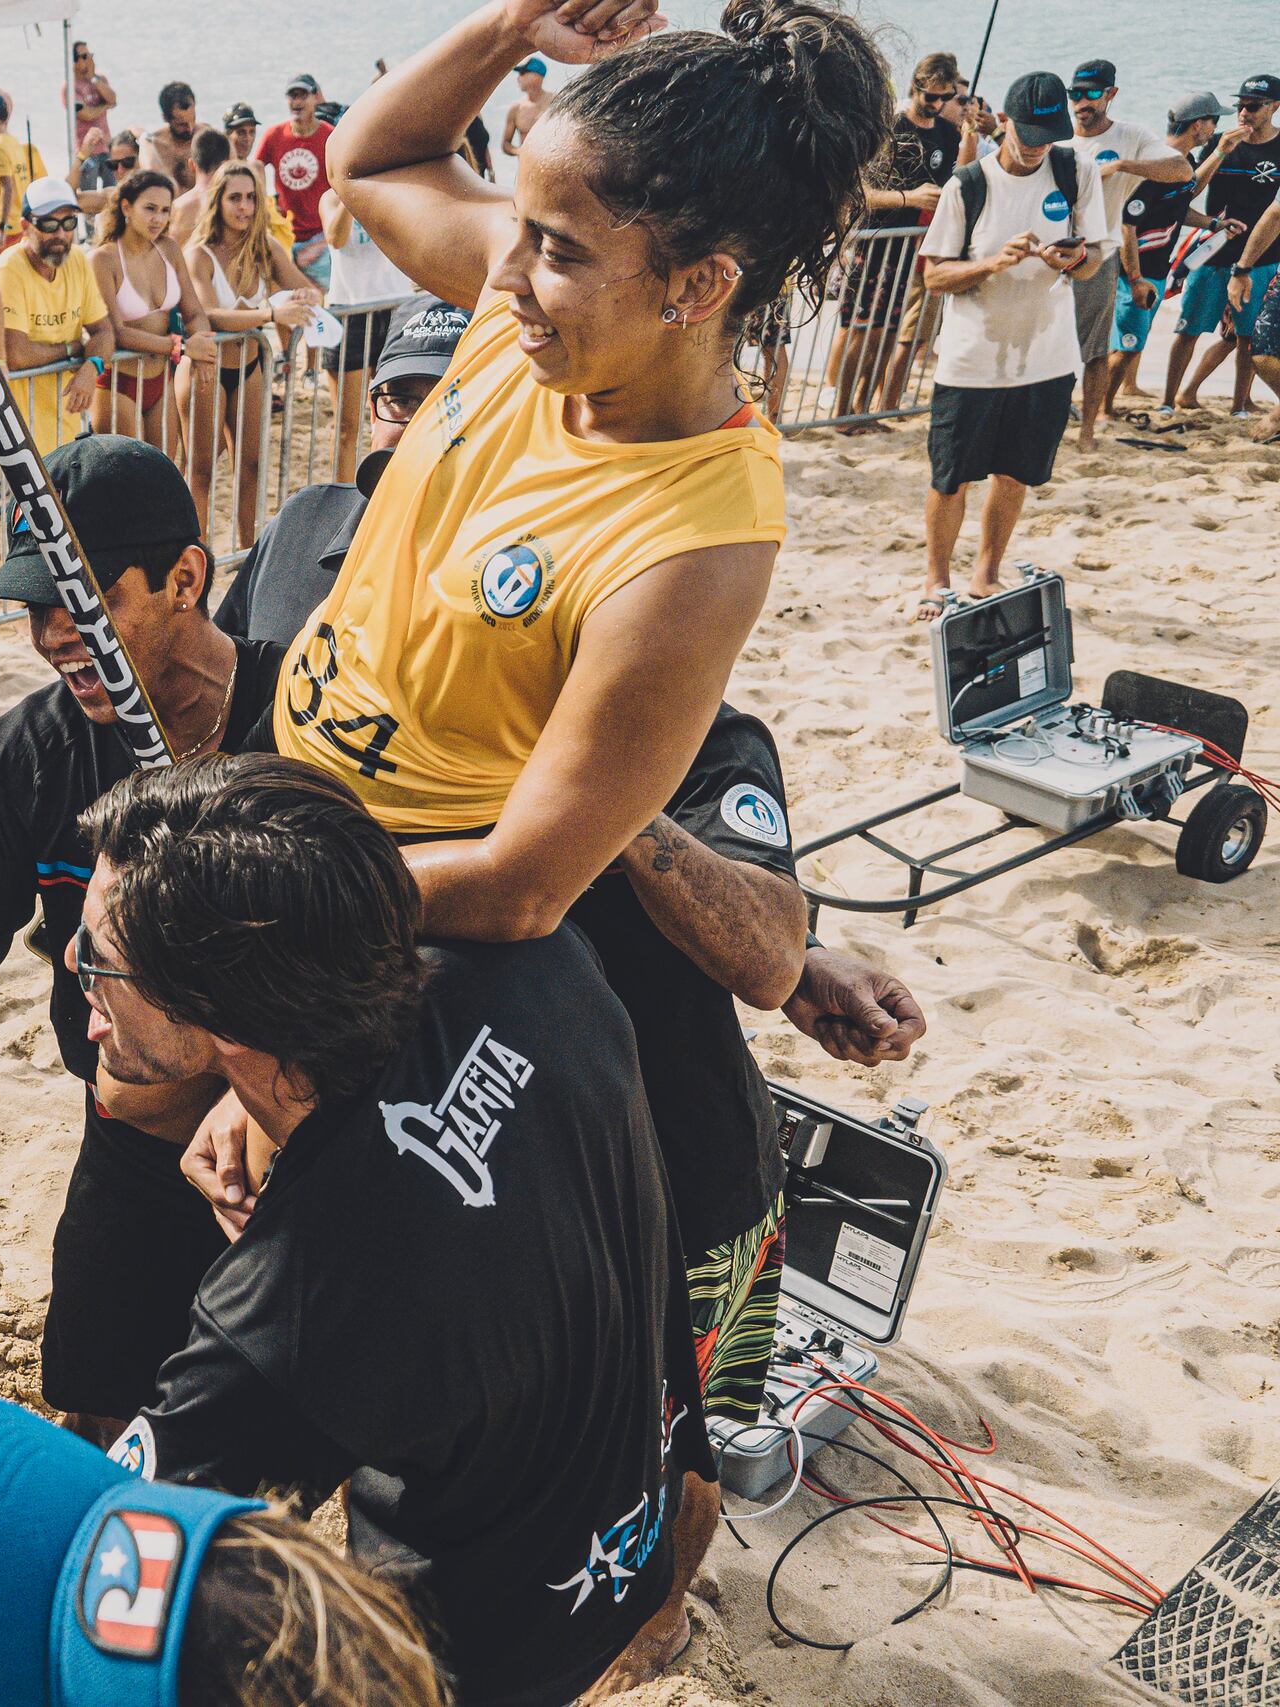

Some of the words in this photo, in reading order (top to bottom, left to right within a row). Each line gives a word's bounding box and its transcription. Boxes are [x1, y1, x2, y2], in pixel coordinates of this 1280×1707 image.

[404, 326, 432, 337] BLACK
[435, 325, 465, 334] HAWK
[470, 579, 483, 613] PUERTO
[480, 612, 497, 628] RICO
[843, 1224, 870, 1241] MYLAPS
[836, 1255, 862, 1271] MYLAPS
